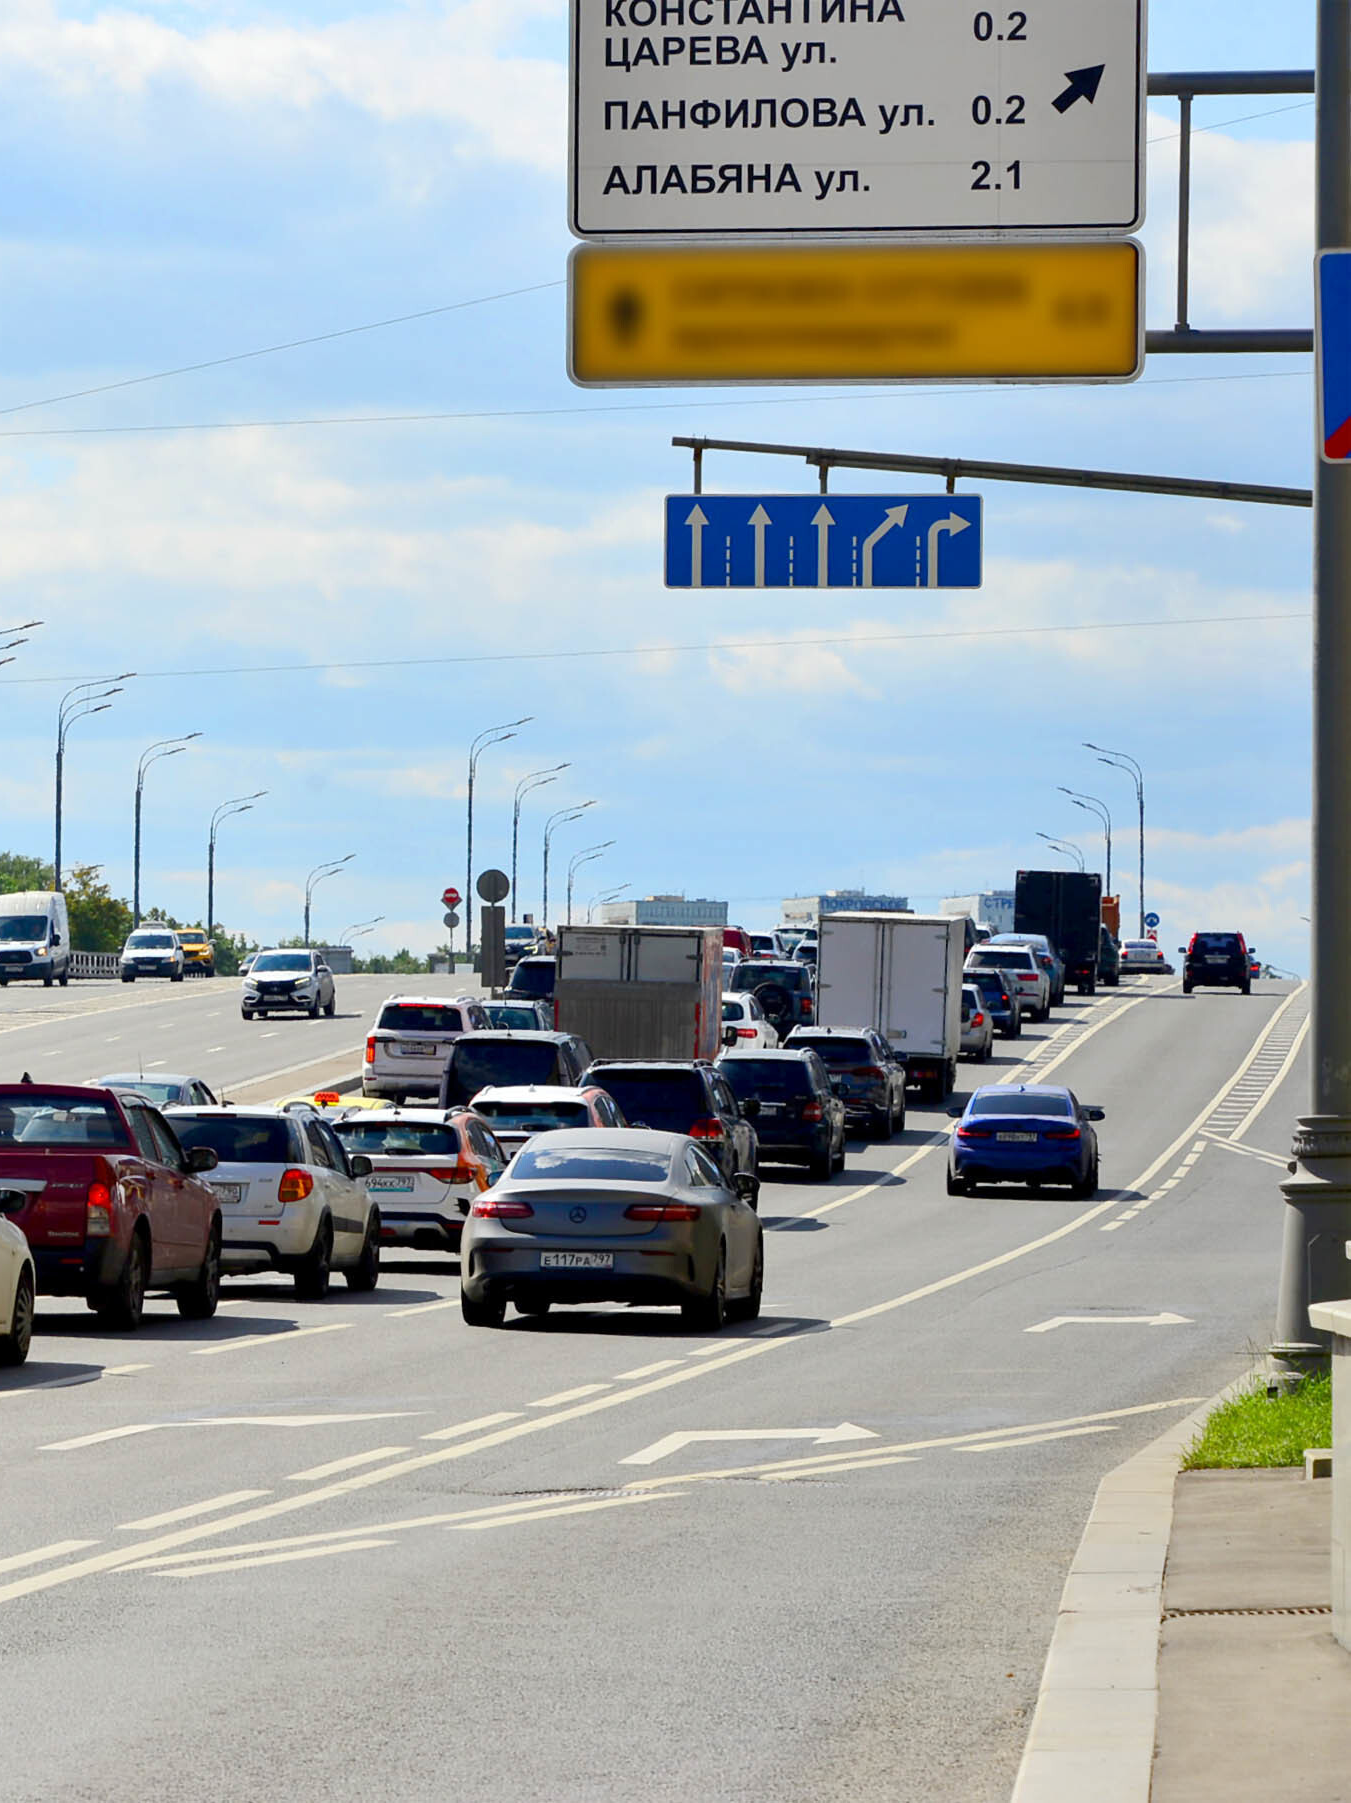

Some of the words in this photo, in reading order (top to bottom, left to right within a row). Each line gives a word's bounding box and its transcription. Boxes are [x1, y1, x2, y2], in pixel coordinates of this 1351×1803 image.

[605, 0, 905, 27] КОНСТАНТИНА
[973, 11, 1027, 41] 0.2
[605, 35, 768, 72] ЦАРЕВА
[781, 42, 837, 72] ул.
[604, 97, 866, 130] ПАНФИЛОВА
[879, 104, 935, 135] ул.
[971, 95, 1026, 125] 0.2
[602, 163, 802, 195] АЛАБЯНА
[814, 170, 870, 200] ул.
[970, 160, 1021, 190] 2.1
